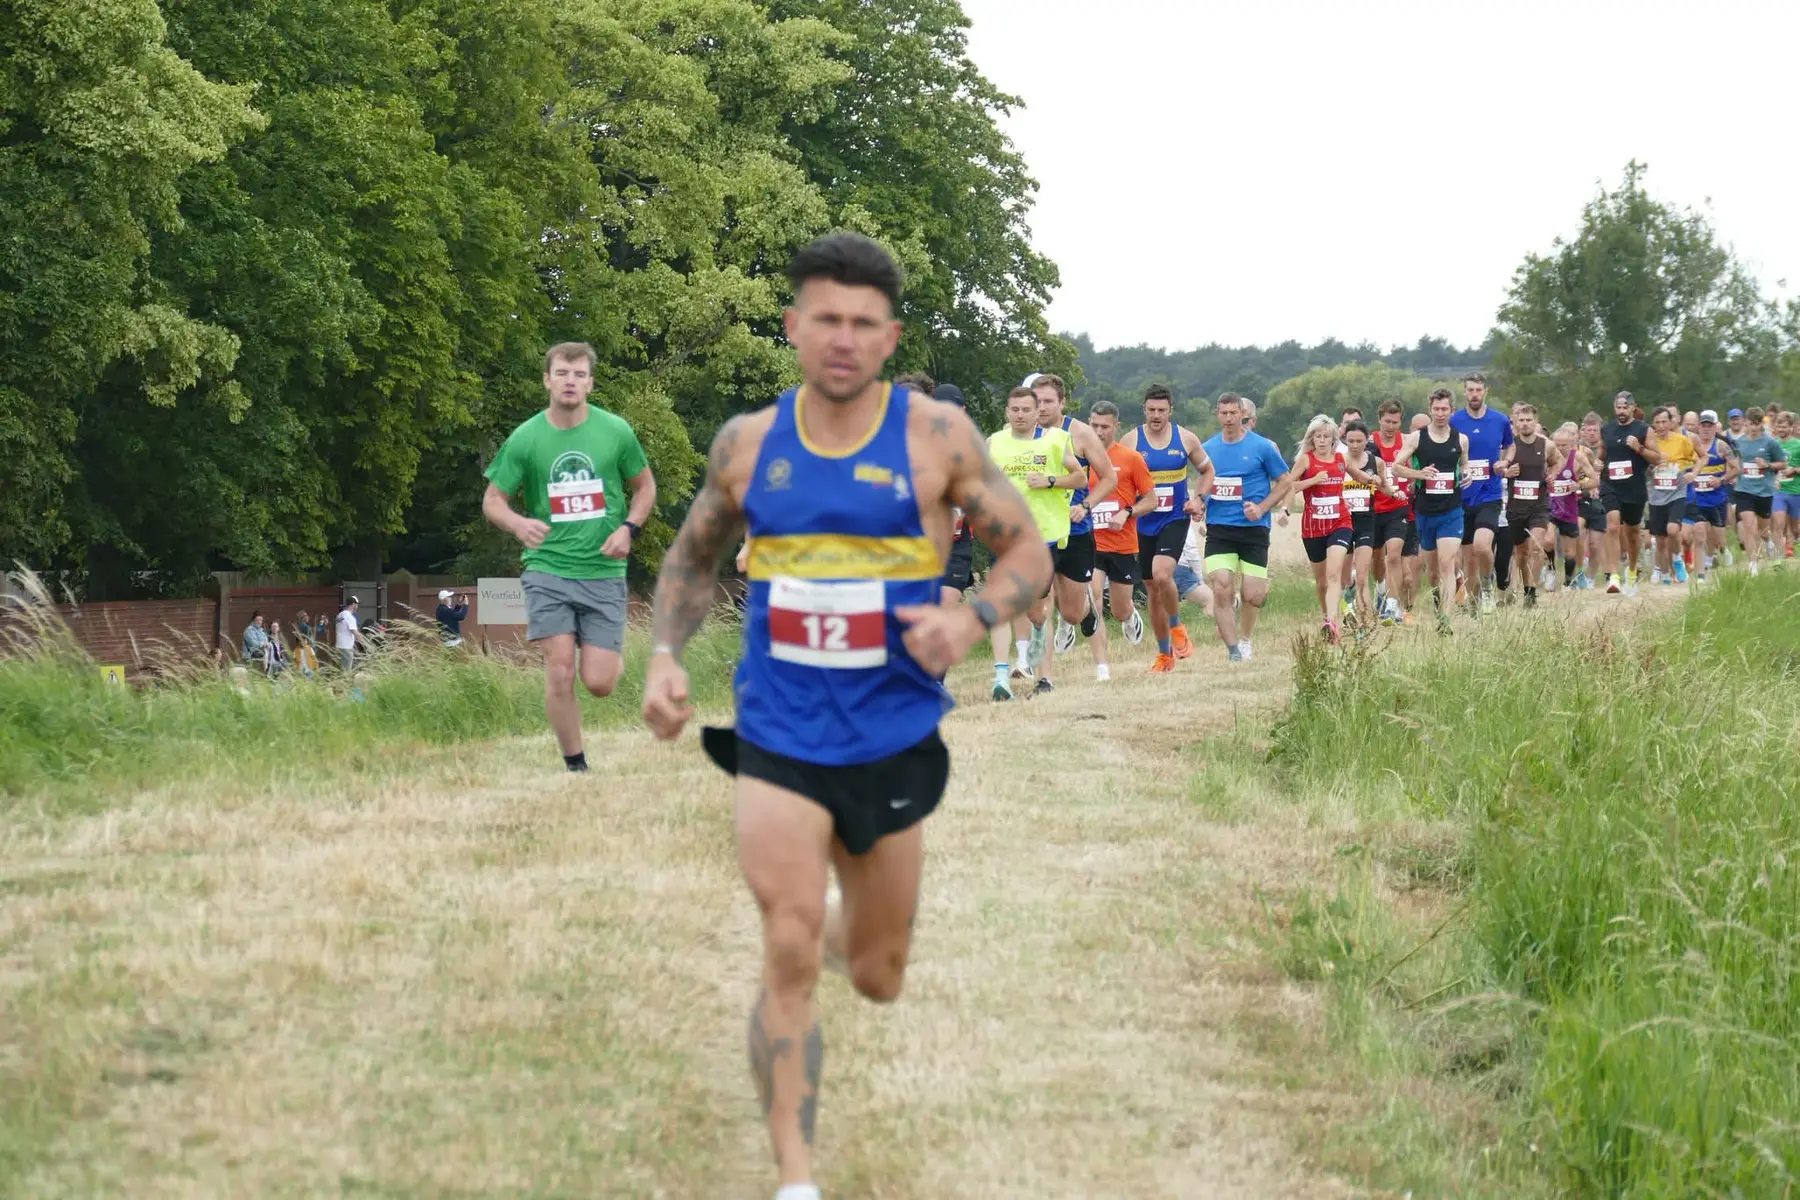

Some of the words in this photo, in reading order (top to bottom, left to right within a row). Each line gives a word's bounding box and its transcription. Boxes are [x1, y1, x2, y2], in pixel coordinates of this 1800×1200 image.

[1435, 480, 1446, 489] 42
[1216, 486, 1235, 496] 207
[560, 495, 593, 514] 194
[1317, 504, 1334, 515] 241
[1092, 512, 1112, 524] 318
[480, 590, 521, 600] Westfield
[801, 615, 849, 650] 12
